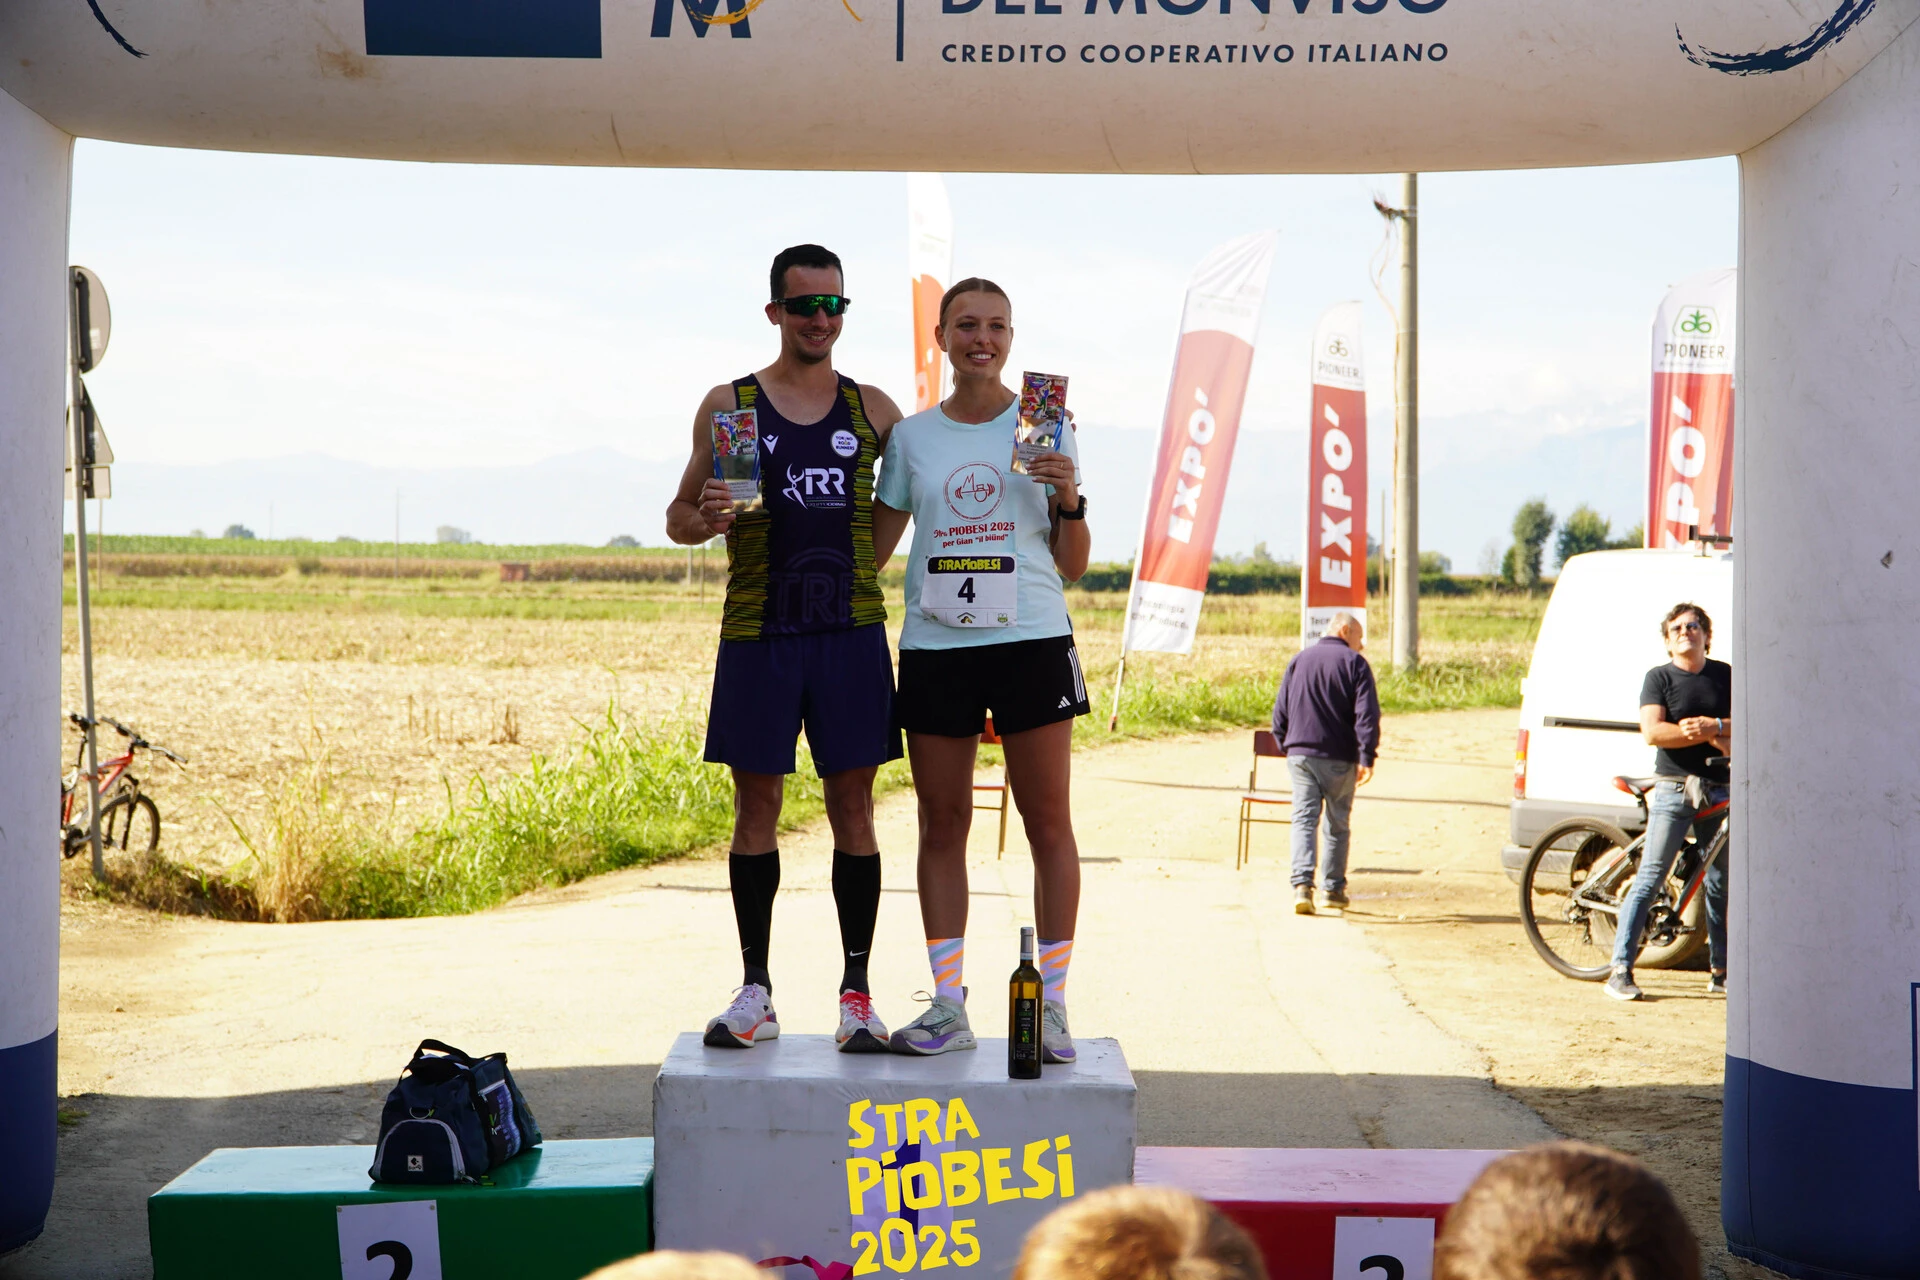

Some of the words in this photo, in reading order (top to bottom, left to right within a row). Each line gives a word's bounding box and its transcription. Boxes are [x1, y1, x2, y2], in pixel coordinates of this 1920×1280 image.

[942, 44, 1066, 63] CREDITO
[1080, 44, 1294, 63] COOPERATIVO
[1308, 43, 1448, 63] ITALIANO
[949, 523, 988, 536] PIOBESI
[990, 522, 1015, 531] 2025
[942, 540, 955, 548] per
[957, 577, 976, 603] 4
